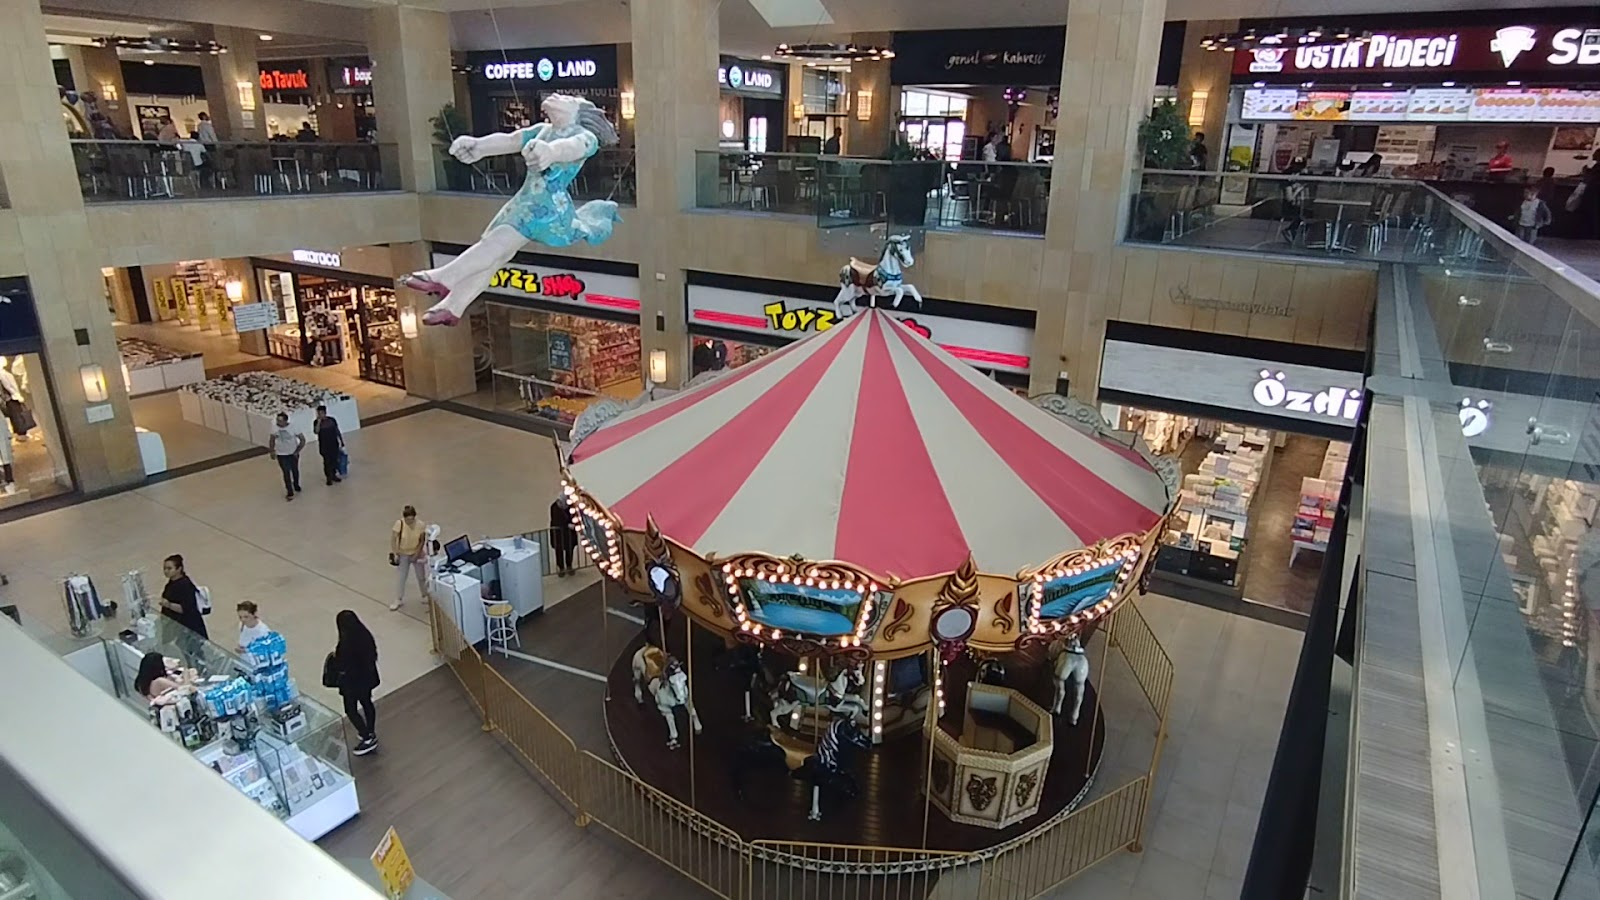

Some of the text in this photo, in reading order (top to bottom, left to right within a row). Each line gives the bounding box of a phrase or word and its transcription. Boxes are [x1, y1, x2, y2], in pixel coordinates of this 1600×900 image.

[272, 69, 308, 88] Tavuk
[485, 60, 596, 79] COFFEE LAND
[744, 71, 772, 88] LAND
[489, 268, 540, 293] OYZZ
[1253, 369, 1361, 420] Özdi
